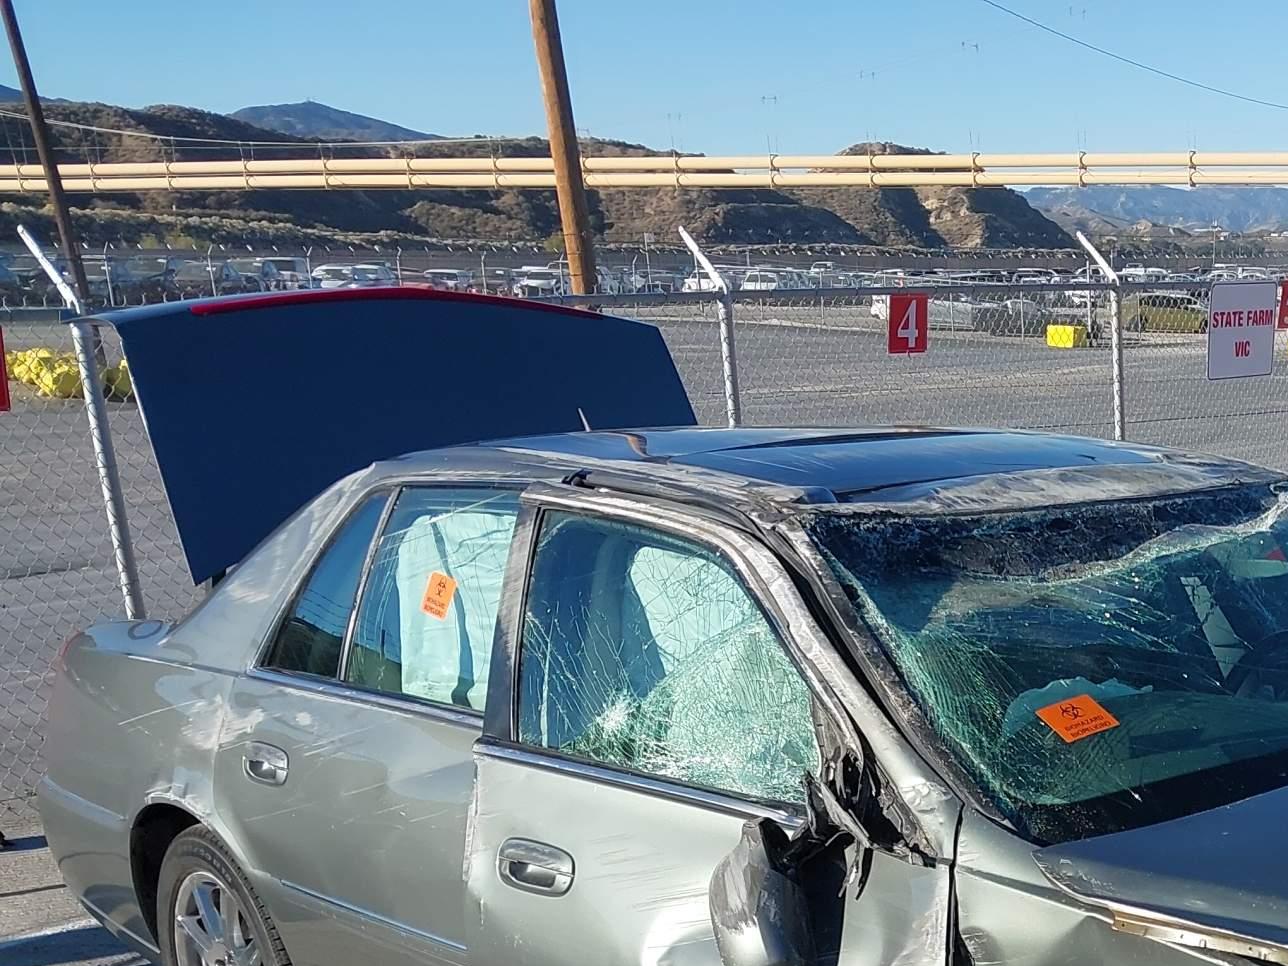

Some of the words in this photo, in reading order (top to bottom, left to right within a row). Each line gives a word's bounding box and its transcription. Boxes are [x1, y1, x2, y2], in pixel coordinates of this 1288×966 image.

[897, 299, 919, 348] 4
[1212, 310, 1244, 328] STATE
[1246, 309, 1273, 327] FARM
[1234, 340, 1250, 357] VIC
